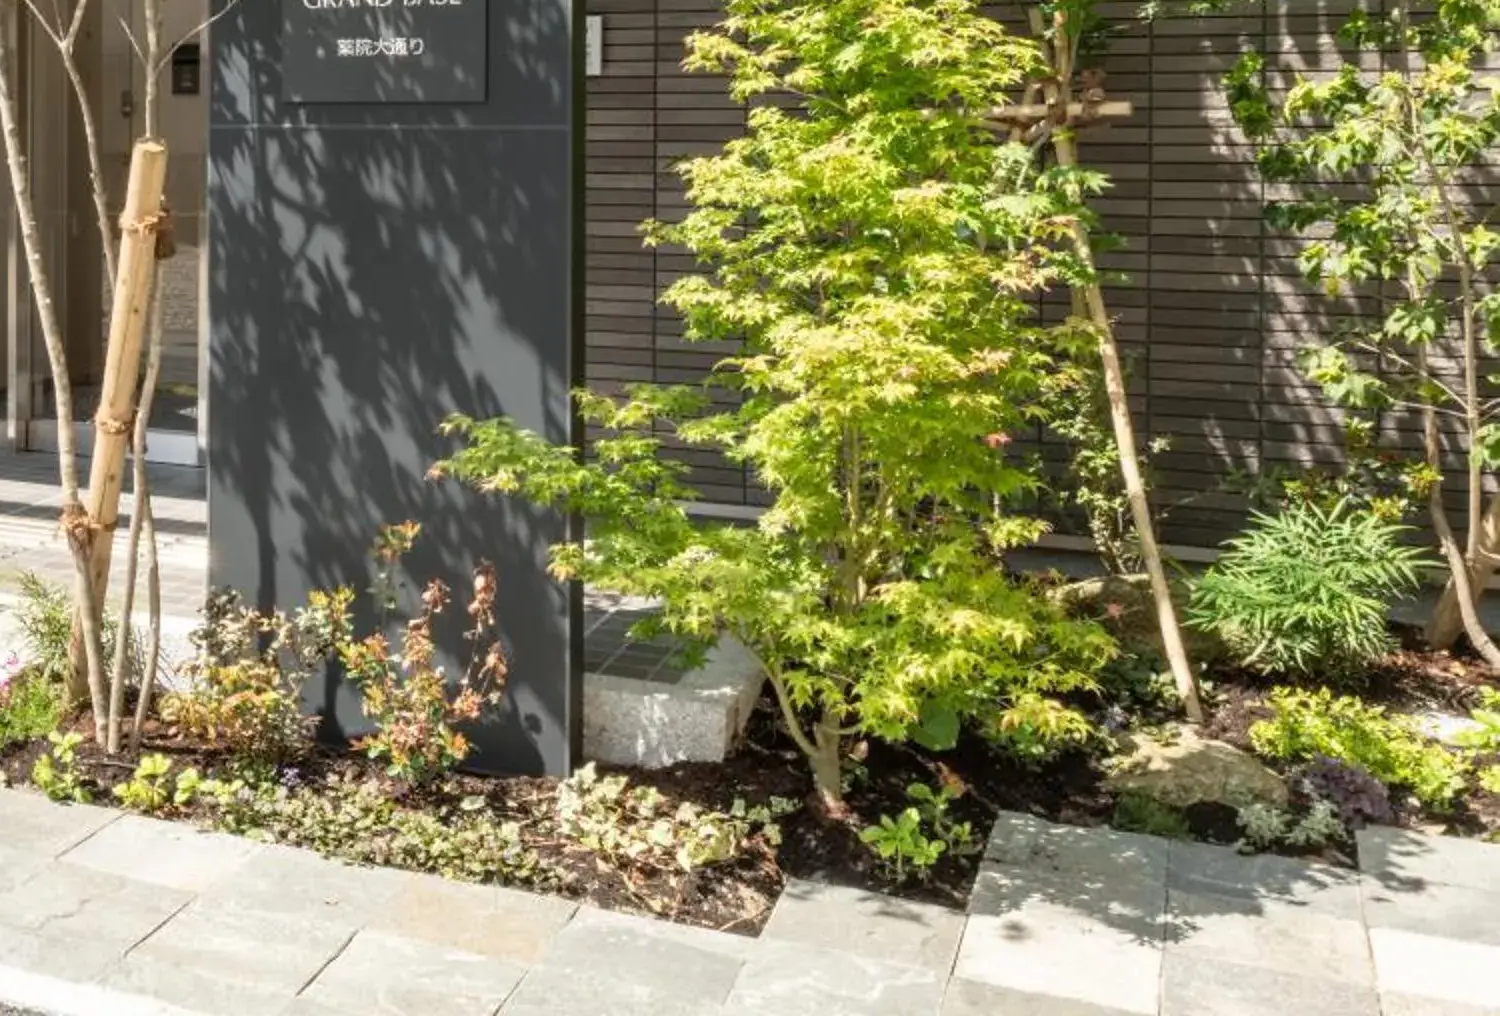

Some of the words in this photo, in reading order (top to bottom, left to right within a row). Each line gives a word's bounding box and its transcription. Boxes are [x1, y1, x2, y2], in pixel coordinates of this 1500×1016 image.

[337, 37, 424, 57] 薬院大通り
